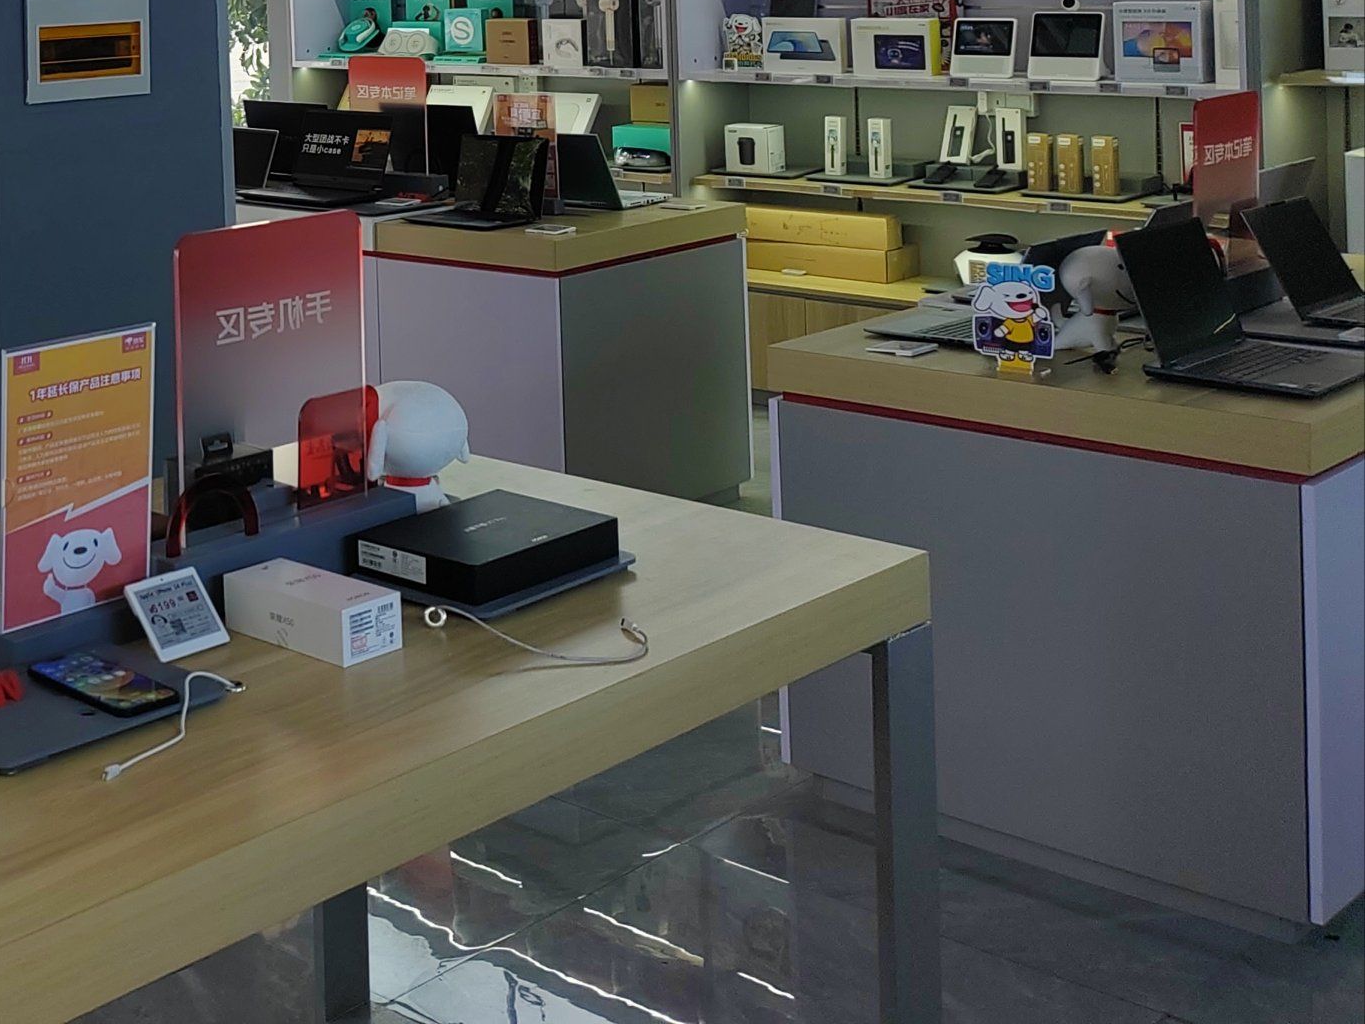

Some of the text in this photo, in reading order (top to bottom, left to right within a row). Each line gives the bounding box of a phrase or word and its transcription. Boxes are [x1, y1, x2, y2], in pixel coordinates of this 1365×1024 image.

[301, 144, 342, 155] 只是小case
[304, 133, 350, 146] 大型团战不卡
[986, 262, 1055, 292] SING
[30, 367, 142, 402] 1年延长保产品注意事项
